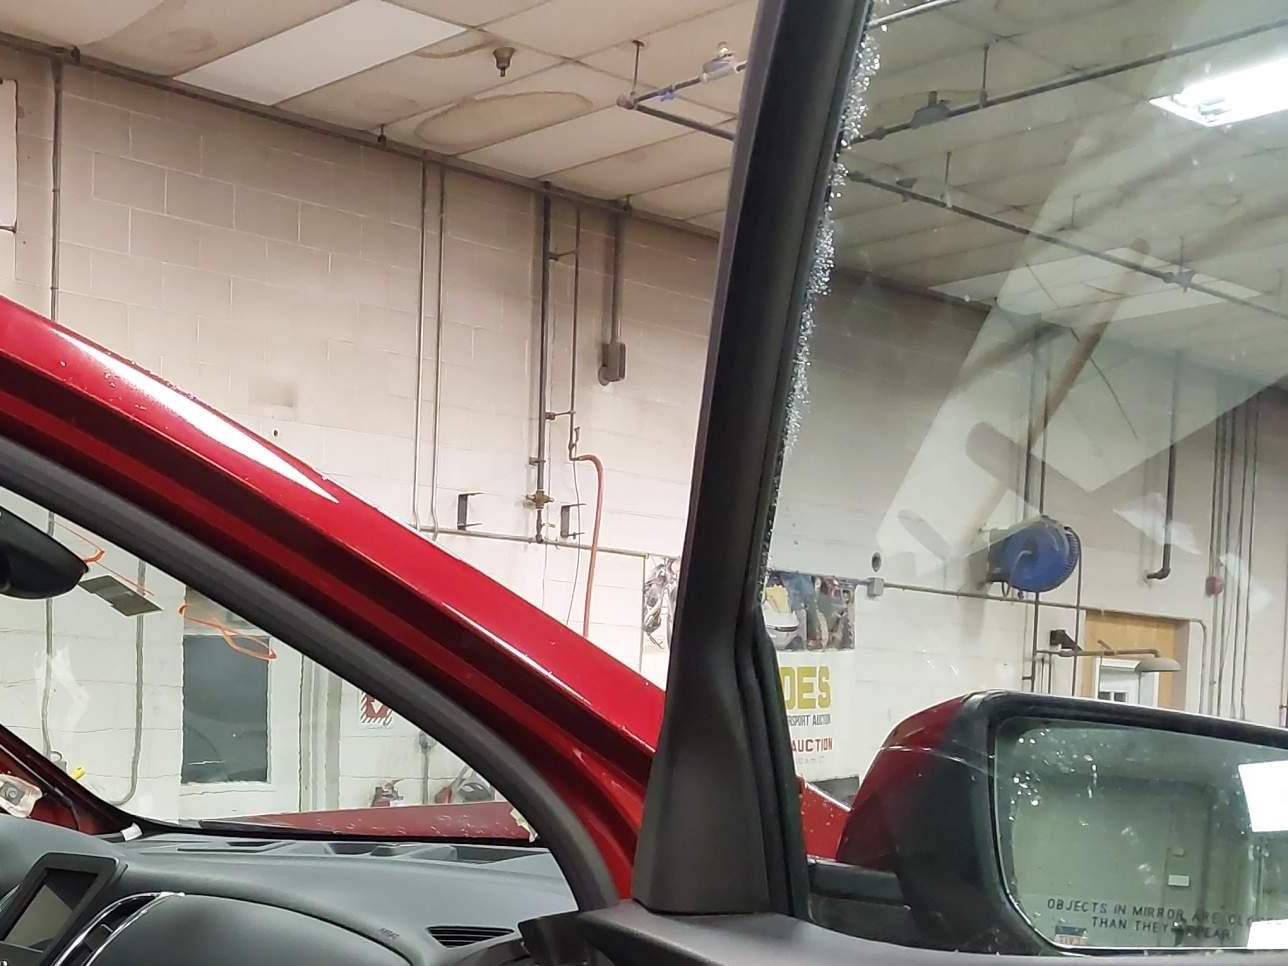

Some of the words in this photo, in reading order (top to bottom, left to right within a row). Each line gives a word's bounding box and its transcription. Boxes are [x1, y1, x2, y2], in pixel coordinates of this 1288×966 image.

[791, 738, 833, 753] AUCTION
[1047, 898, 1108, 914] OBJECTS
[1113, 904, 1127, 916] IN
[1132, 905, 1185, 922] MIRROR
[1192, 910, 1218, 925] ARE
[1091, 915, 1127, 930] THAN
[1134, 919, 1168, 934] THEY
